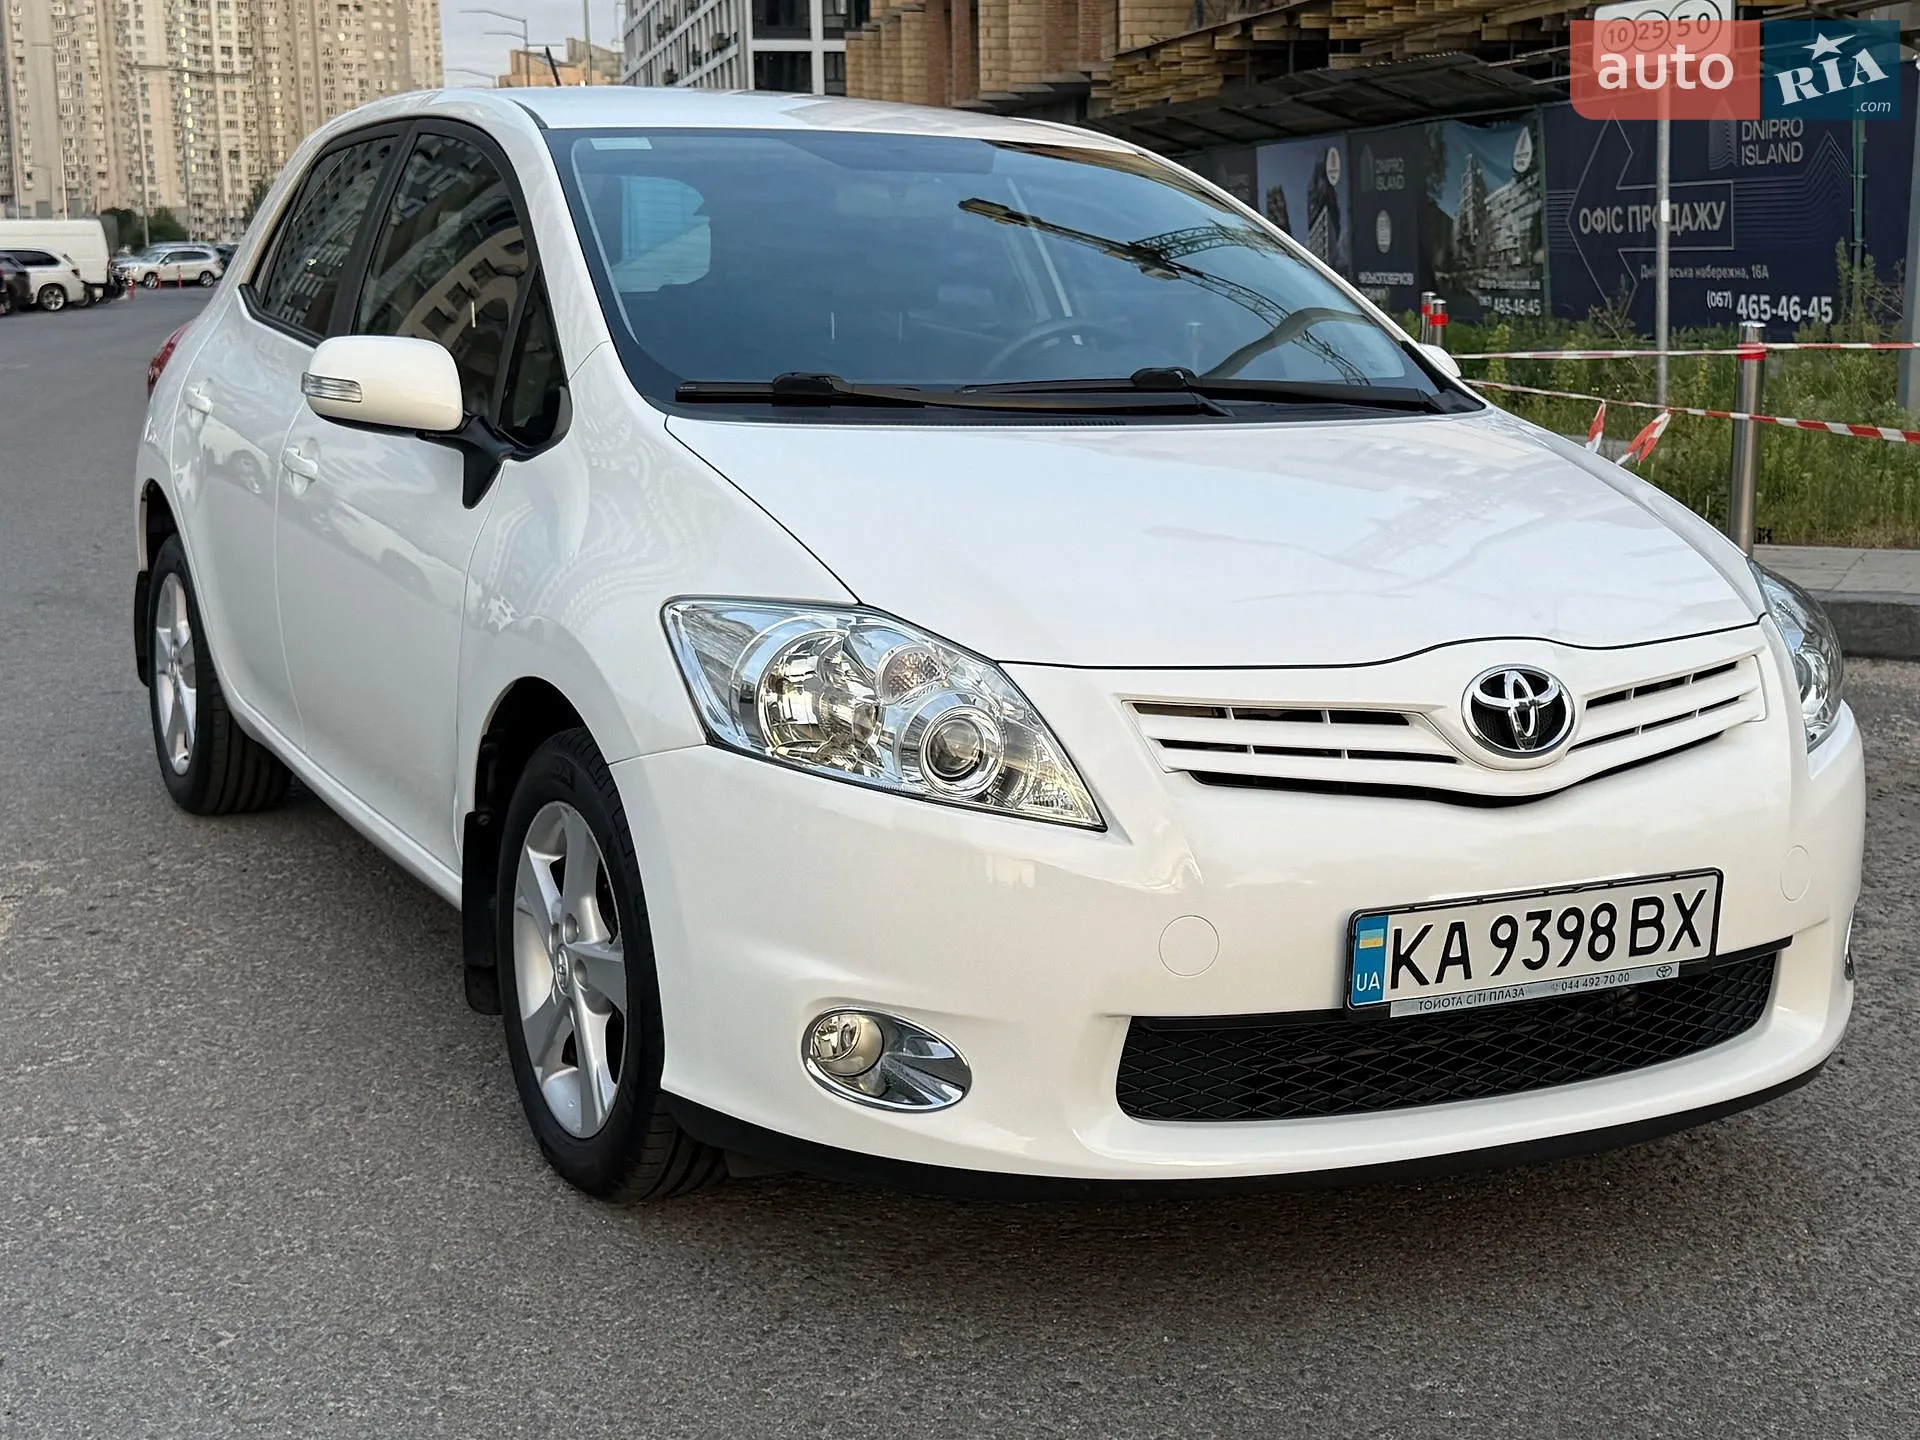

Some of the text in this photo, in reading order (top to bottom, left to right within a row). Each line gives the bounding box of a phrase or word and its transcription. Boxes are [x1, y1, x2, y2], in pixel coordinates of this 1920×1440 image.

[1608, 27, 1628, 45] 10
[1638, 20, 1664, 40] 25
[1741, 118, 1803, 142] DNIPRO
[1741, 141, 1803, 166] ISLAND
[1578, 206, 1624, 235] ОФІС
[1706, 289, 1833, 324] (067) 465-46-45
[1390, 888, 1706, 990] KA 9398 BX
[1356, 972, 1380, 992] UA
[1582, 976, 1601, 989] 492
[1602, 974, 1616, 986] 70
[1617, 971, 1630, 984] 00
